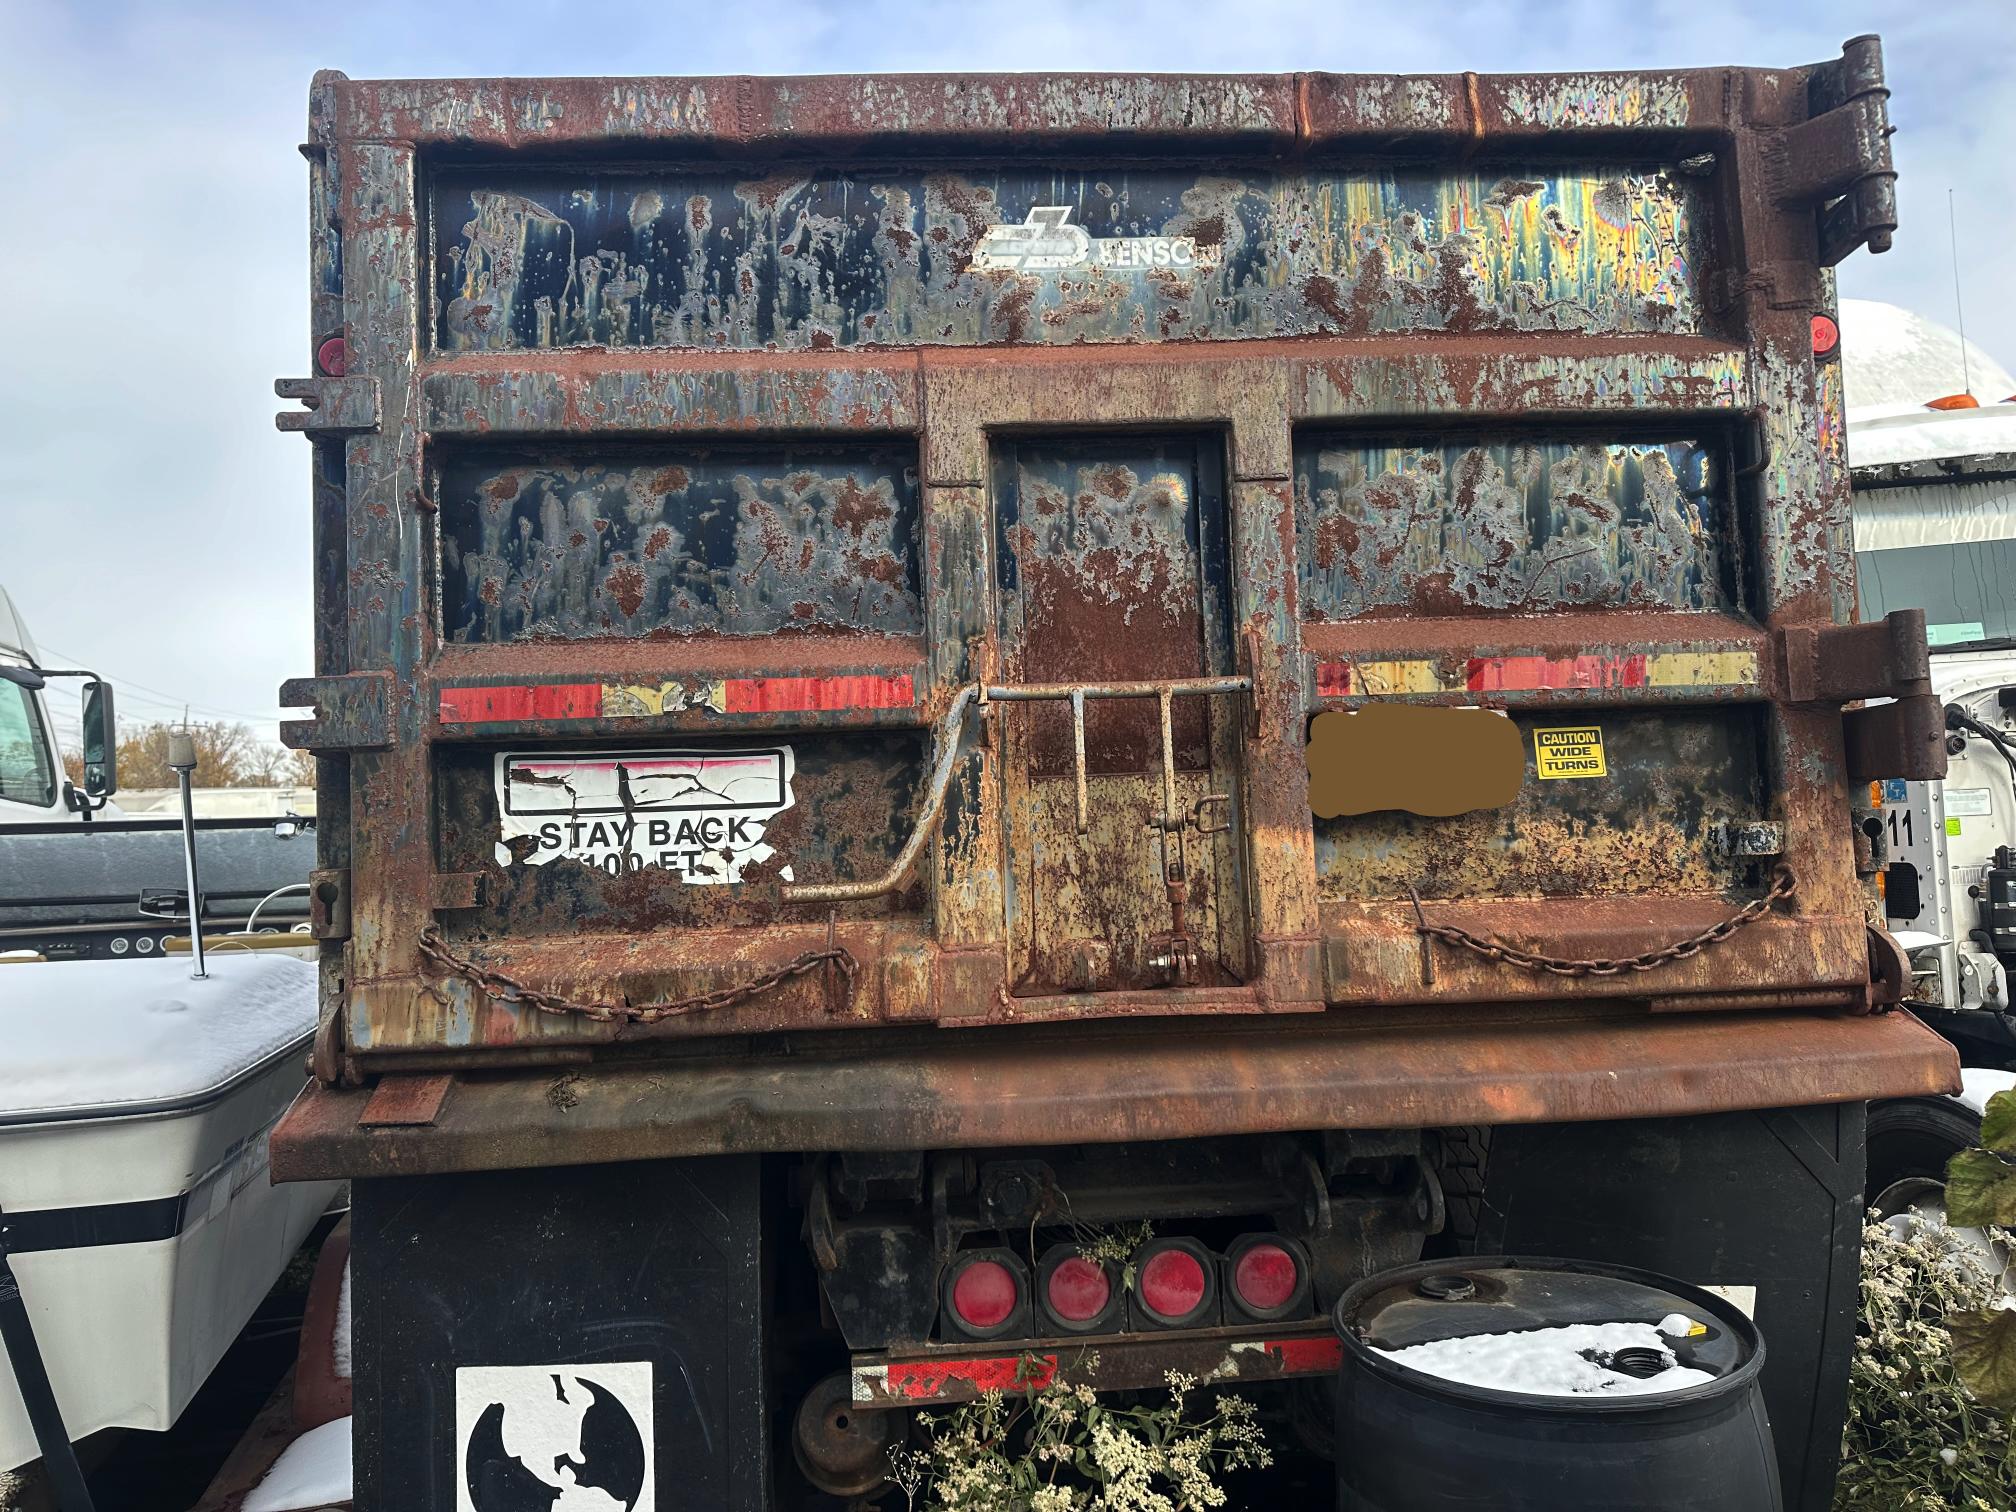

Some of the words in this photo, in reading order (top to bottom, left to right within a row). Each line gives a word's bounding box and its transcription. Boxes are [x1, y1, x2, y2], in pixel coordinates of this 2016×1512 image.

[1543, 733, 1596, 745] CAUTION
[1550, 747, 1591, 757] WIDE
[1545, 760, 1599, 770] TURNS
[540, 821, 631, 850] STAY
[649, 816, 752, 847] BACK
[1887, 809, 1913, 847] 11
